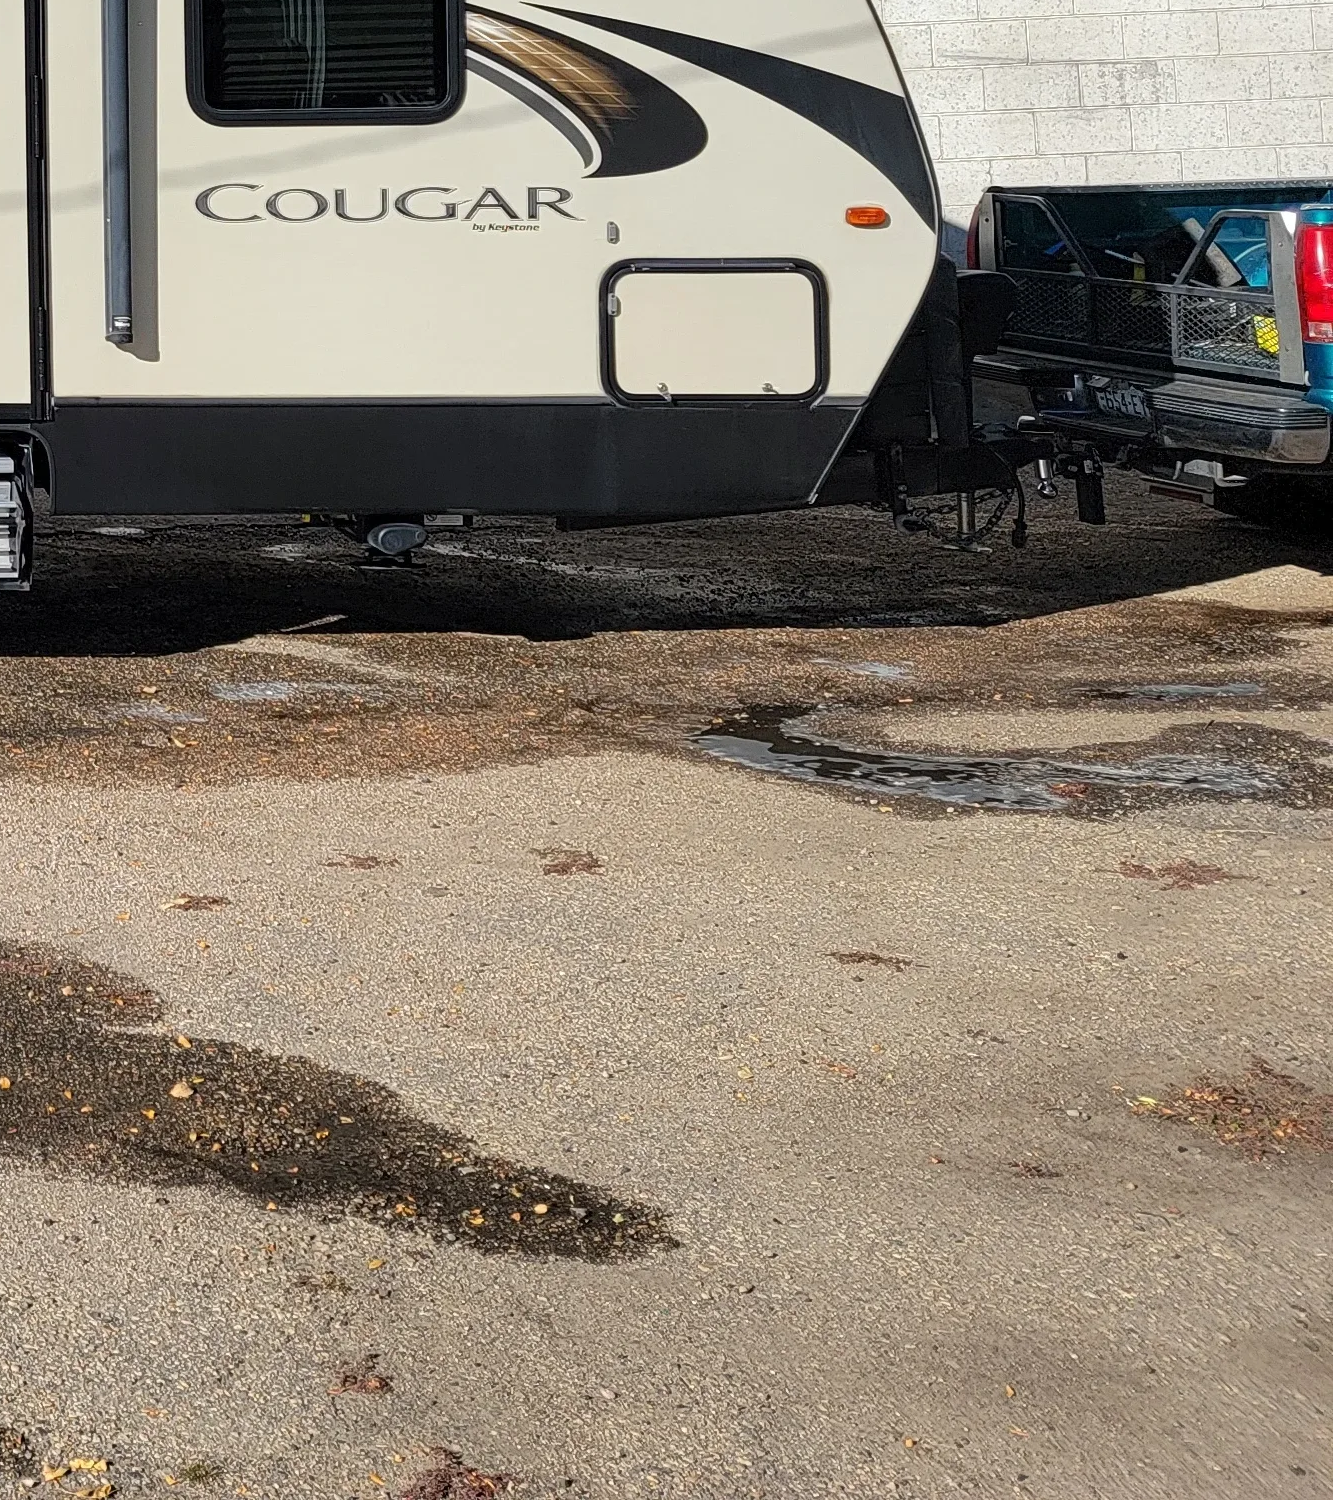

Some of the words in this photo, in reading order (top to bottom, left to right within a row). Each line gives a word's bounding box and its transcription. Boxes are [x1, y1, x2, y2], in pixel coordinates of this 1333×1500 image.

[194, 182, 585, 222] COUGAR
[472, 223, 487, 233] by
[488, 223, 540, 233] Keystone
